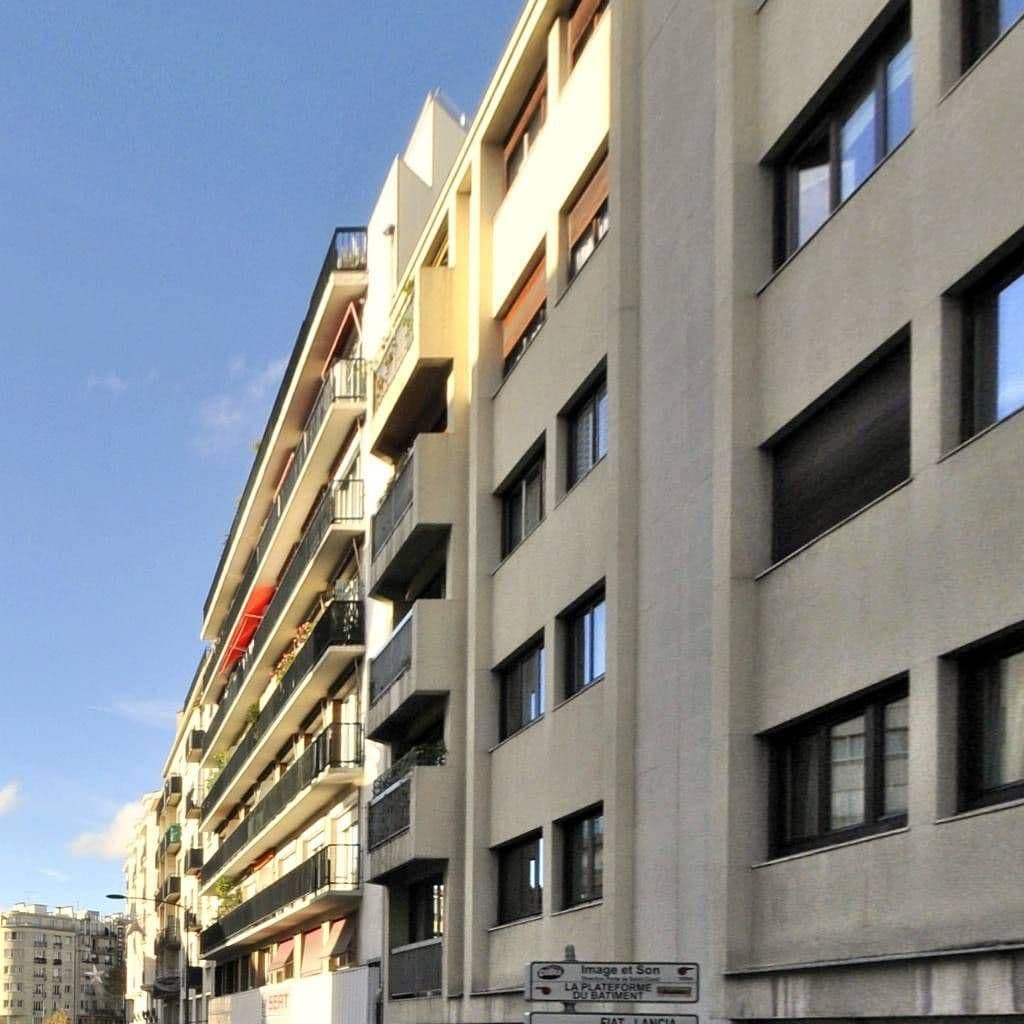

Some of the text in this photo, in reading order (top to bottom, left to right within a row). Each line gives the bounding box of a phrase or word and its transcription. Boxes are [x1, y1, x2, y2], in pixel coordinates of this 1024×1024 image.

[581, 965, 660, 976] Image et Son
[565, 983, 652, 992] LA PLATEFORME
[573, 991, 644, 1000] DU BATIMENT
